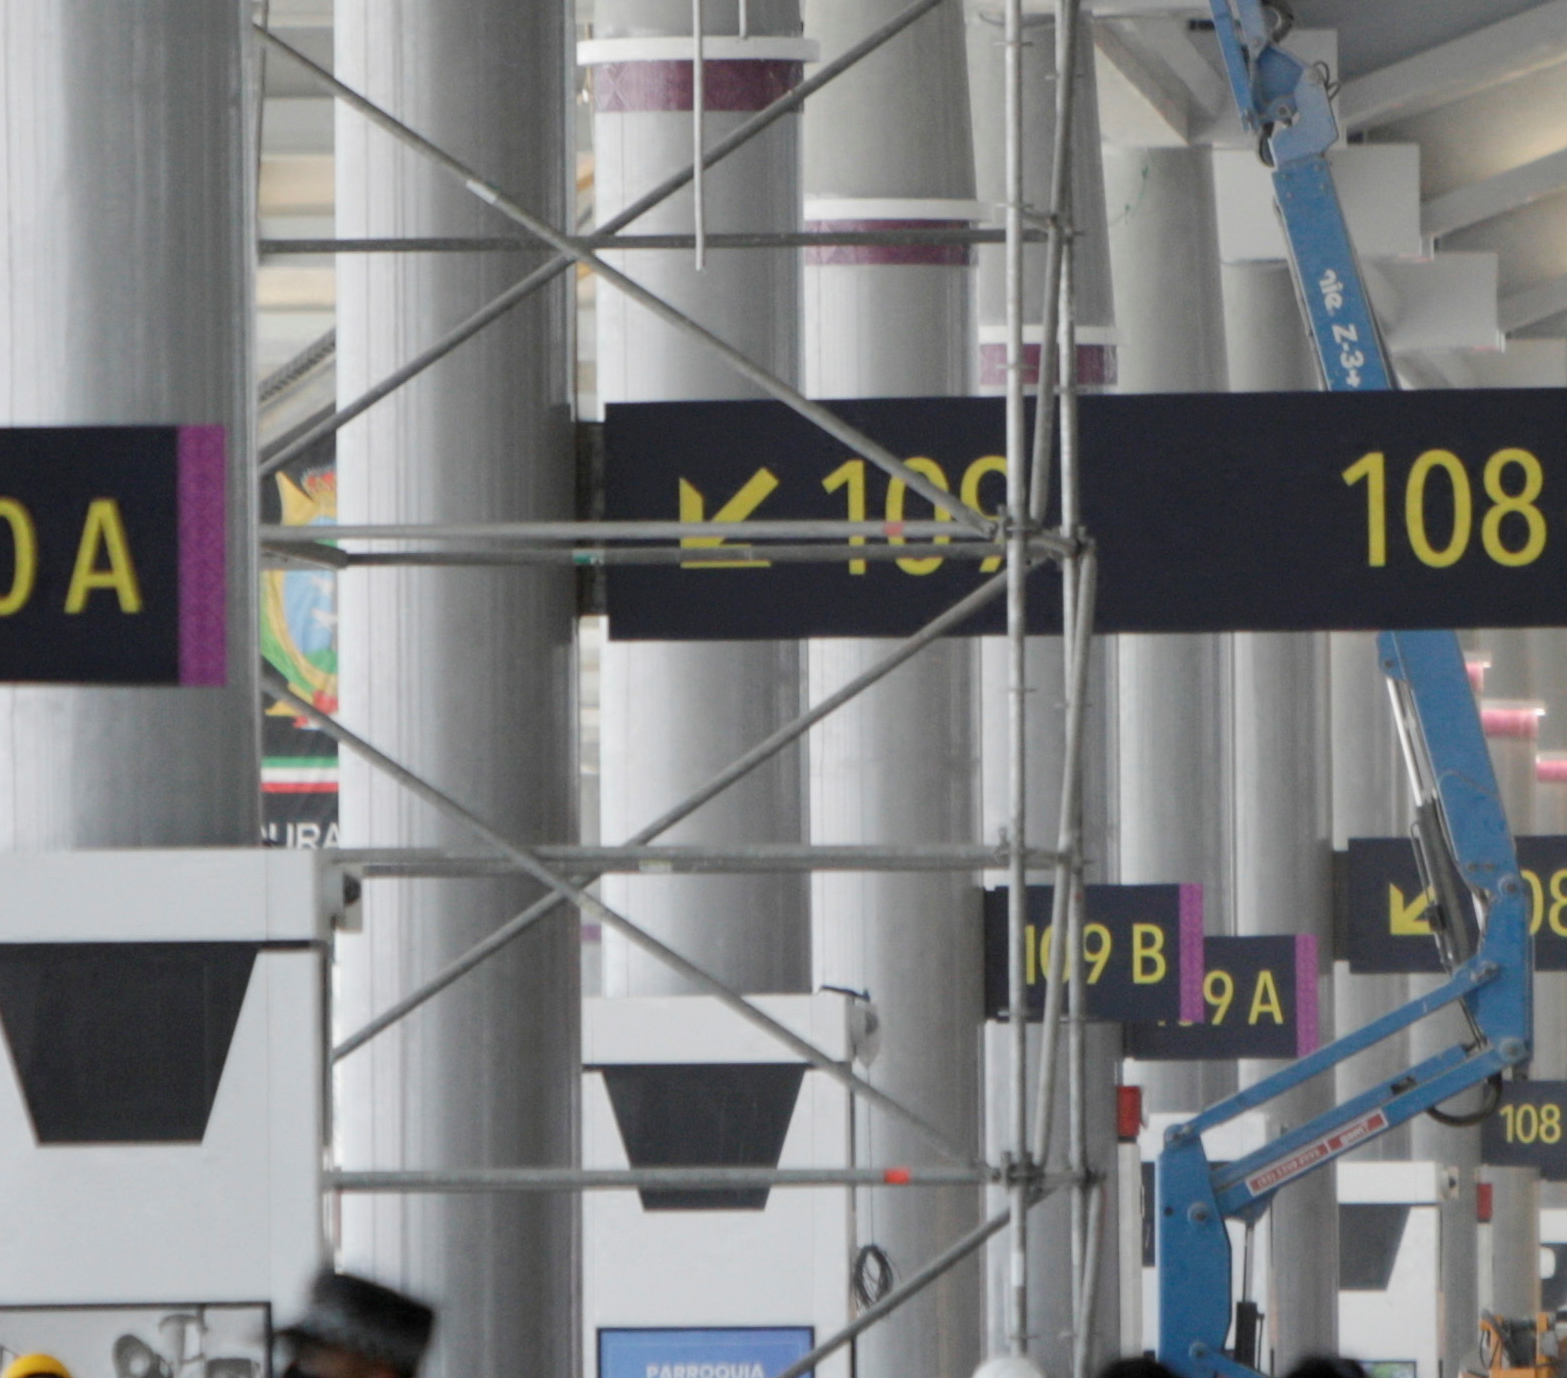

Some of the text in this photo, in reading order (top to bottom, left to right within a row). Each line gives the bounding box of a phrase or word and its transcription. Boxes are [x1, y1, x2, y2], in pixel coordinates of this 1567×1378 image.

[64, 498, 142, 614] A
[1133, 923, 1167, 984] B
[1247, 970, 1283, 1024] A
[1499, 1103, 1562, 1144] 108
